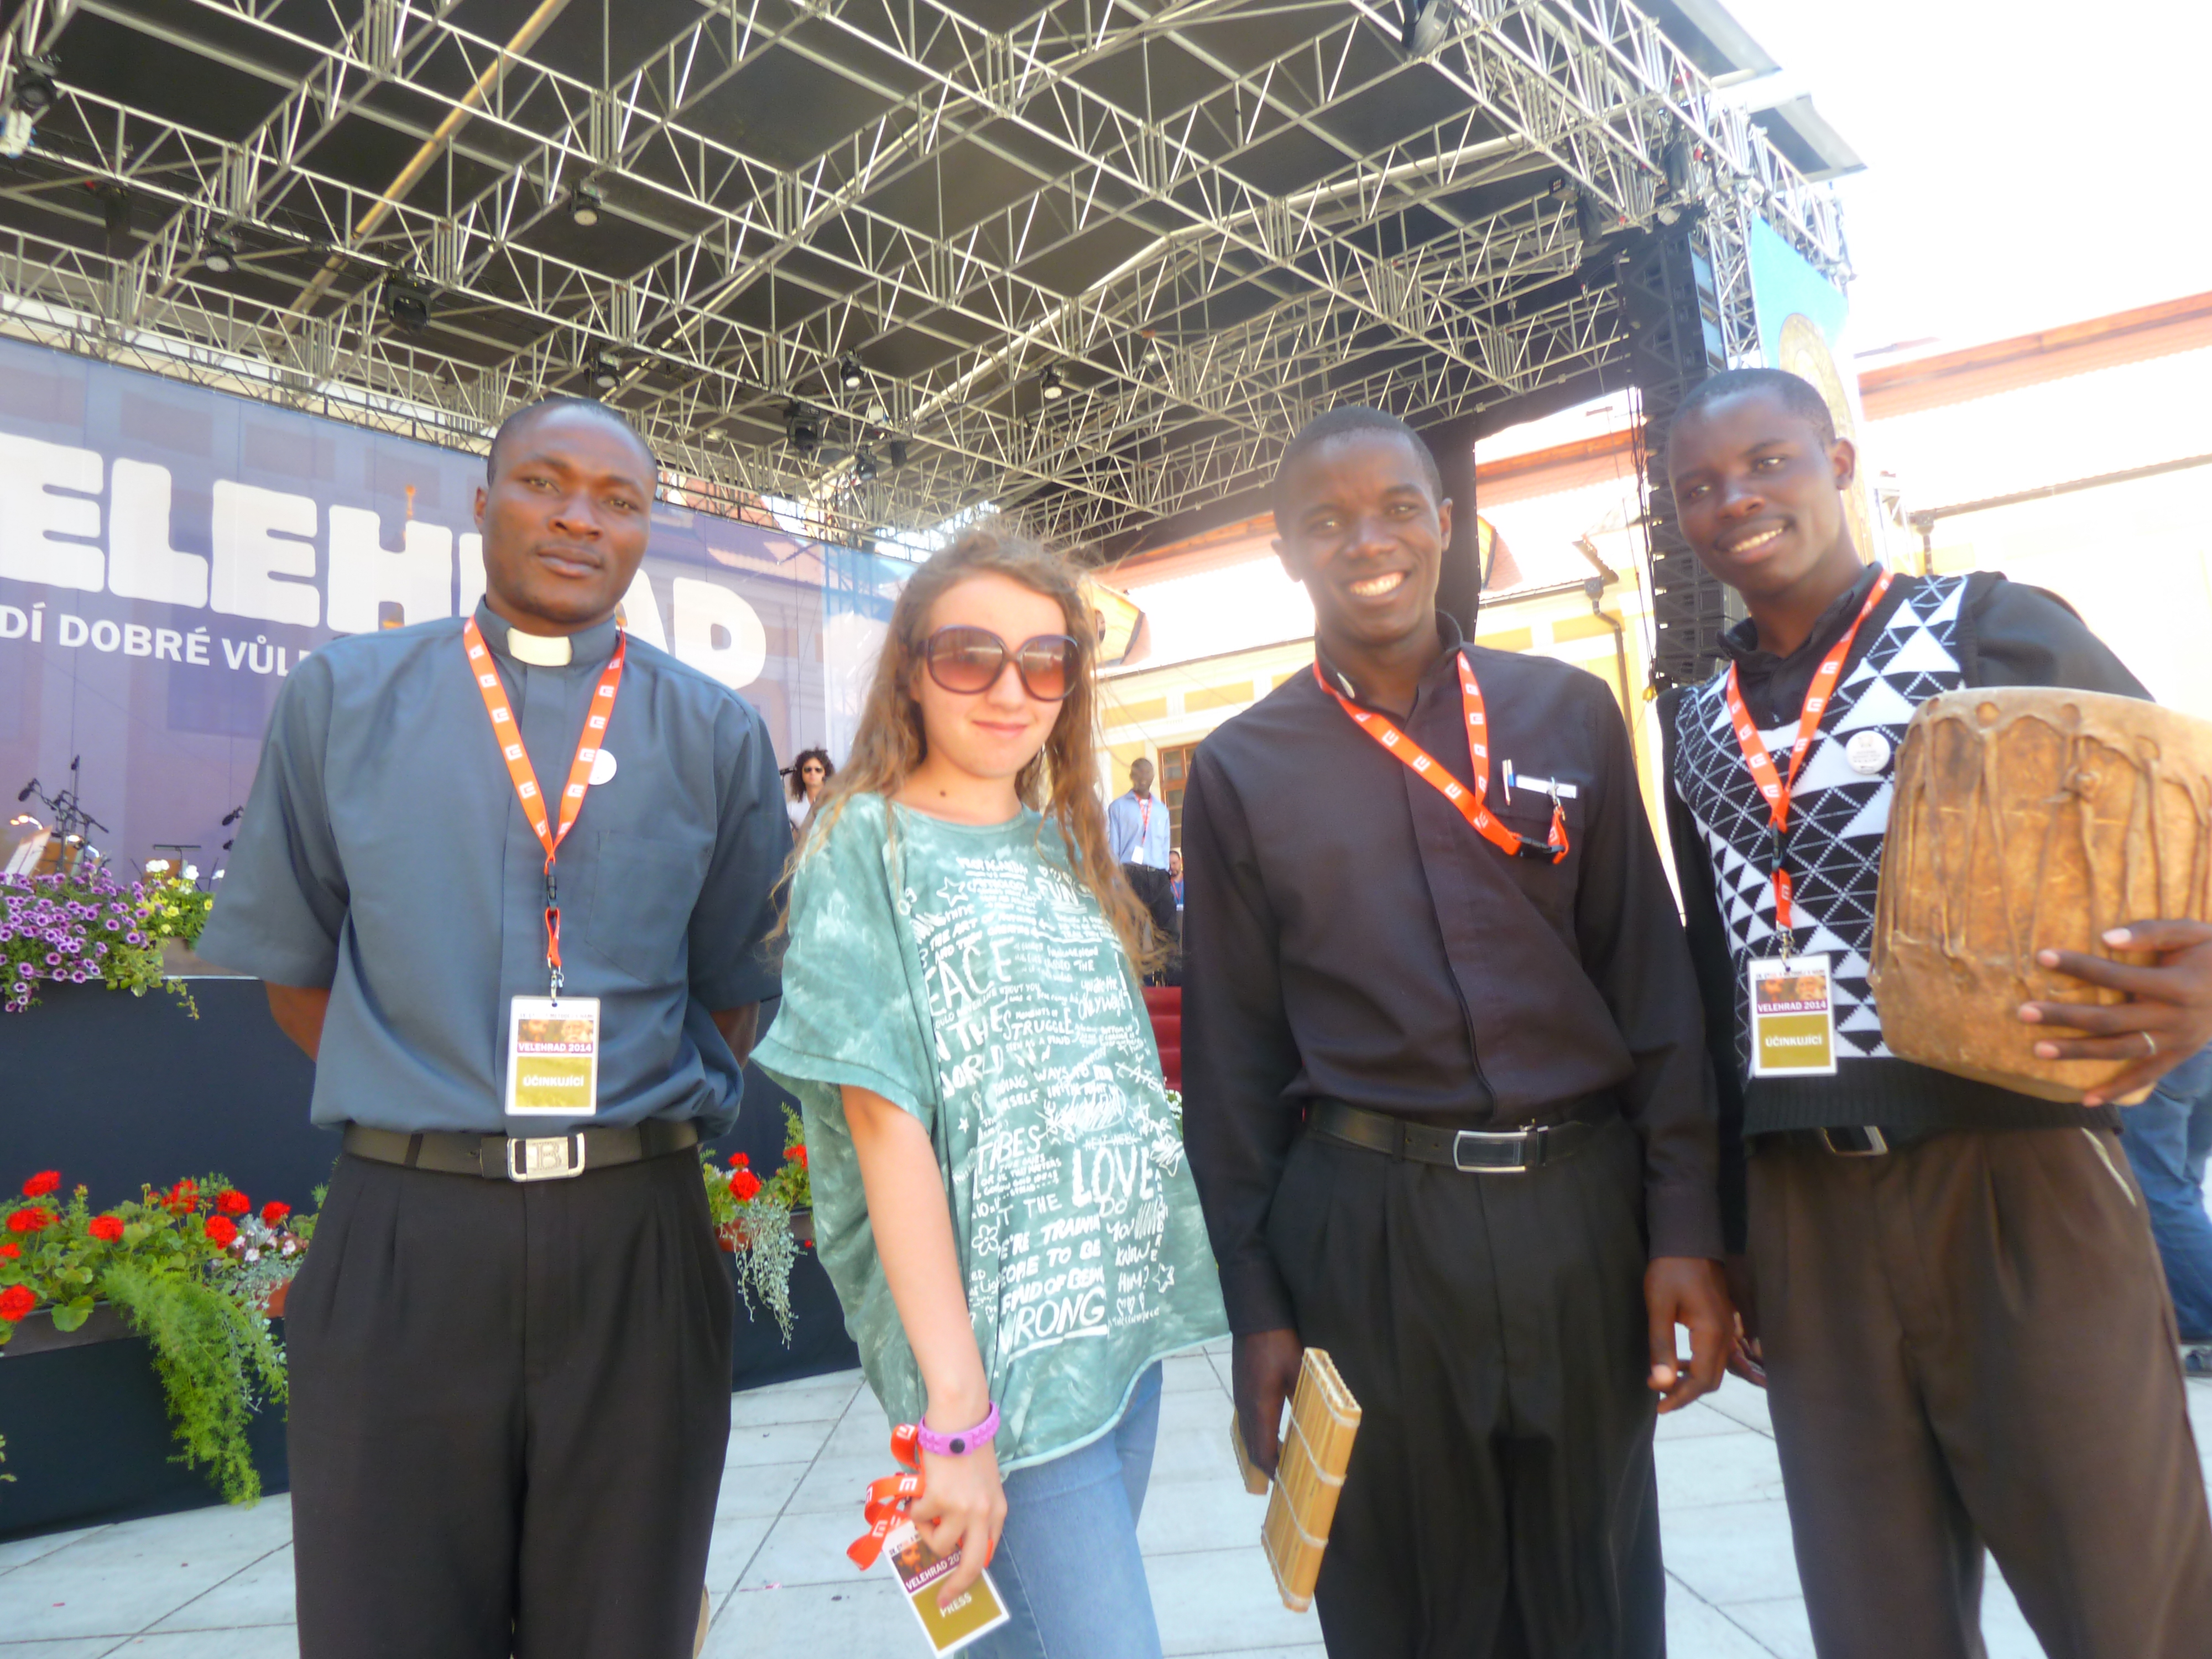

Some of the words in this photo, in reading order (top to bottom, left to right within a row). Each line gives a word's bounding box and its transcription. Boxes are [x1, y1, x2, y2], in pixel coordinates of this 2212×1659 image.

[59, 613, 210, 666] DOBRÉ
[1757, 1001, 1802, 1013] VELEHRAD
[1804, 1000, 1827, 1011] 2014
[518, 1043, 566, 1052] VELEHRAD
[568, 1044, 592, 1052] 2014
[1072, 1144, 1154, 1208] LOVE
[1023, 1193, 1063, 1219] THE
[1046, 1247, 1072, 1267] TO
[998, 1286, 1107, 1355] WRONG
[905, 1559, 948, 1591] VELEHRAD
